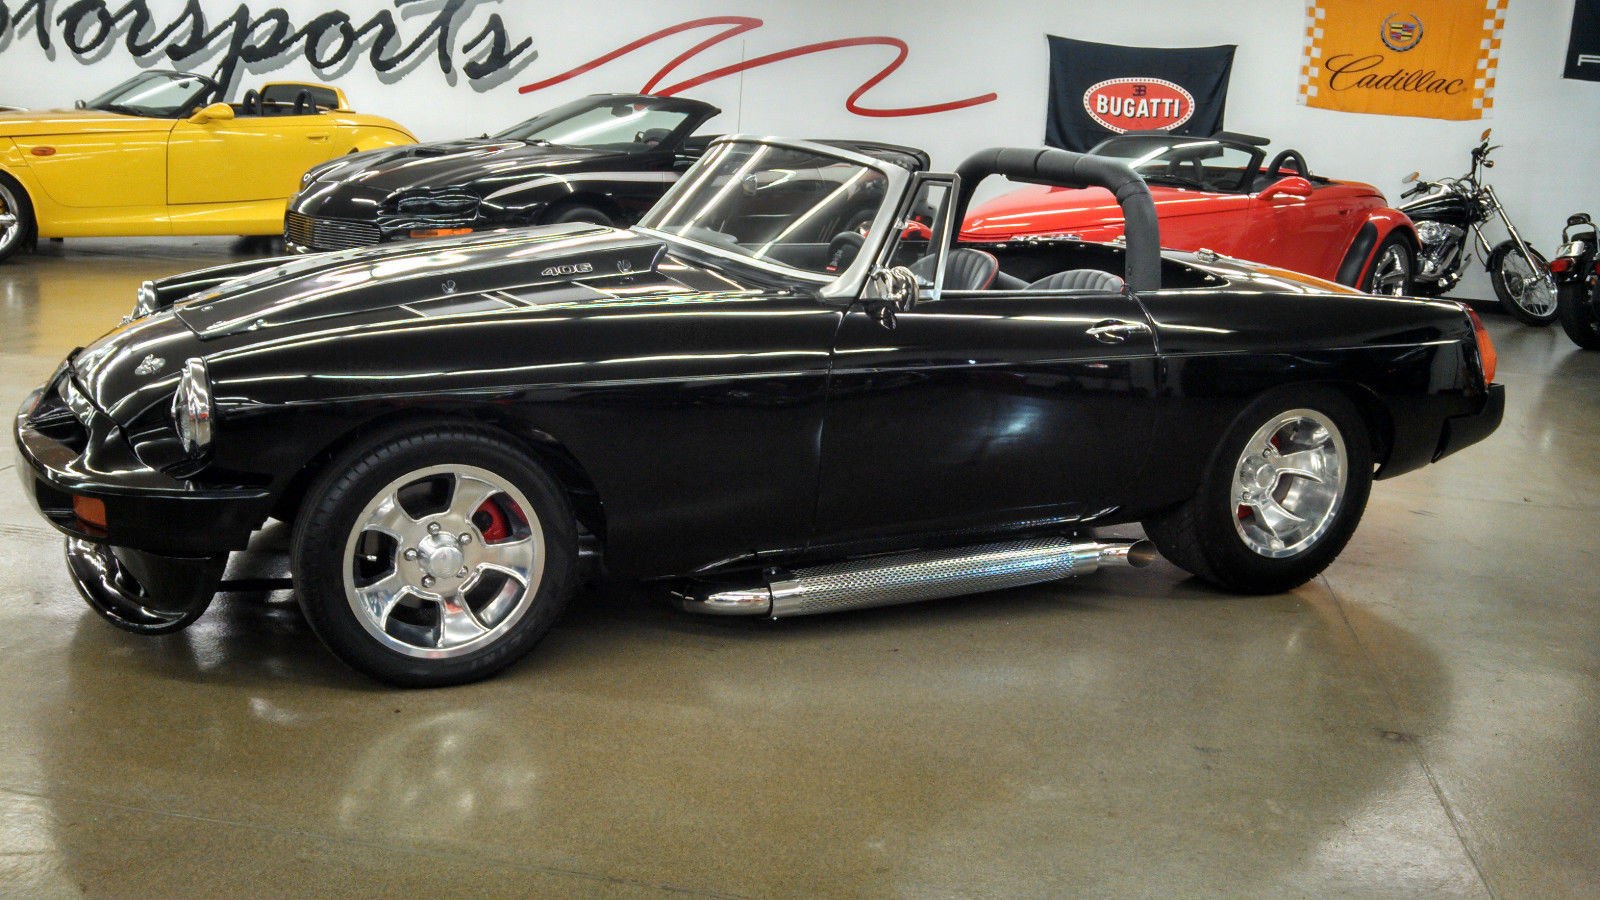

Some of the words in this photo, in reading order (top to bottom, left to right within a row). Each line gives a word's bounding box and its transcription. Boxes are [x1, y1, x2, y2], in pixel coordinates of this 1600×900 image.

[1325, 54, 1464, 95] Cadillac
[1096, 94, 1180, 119] BUGATTI
[541, 262, 594, 277] 406
